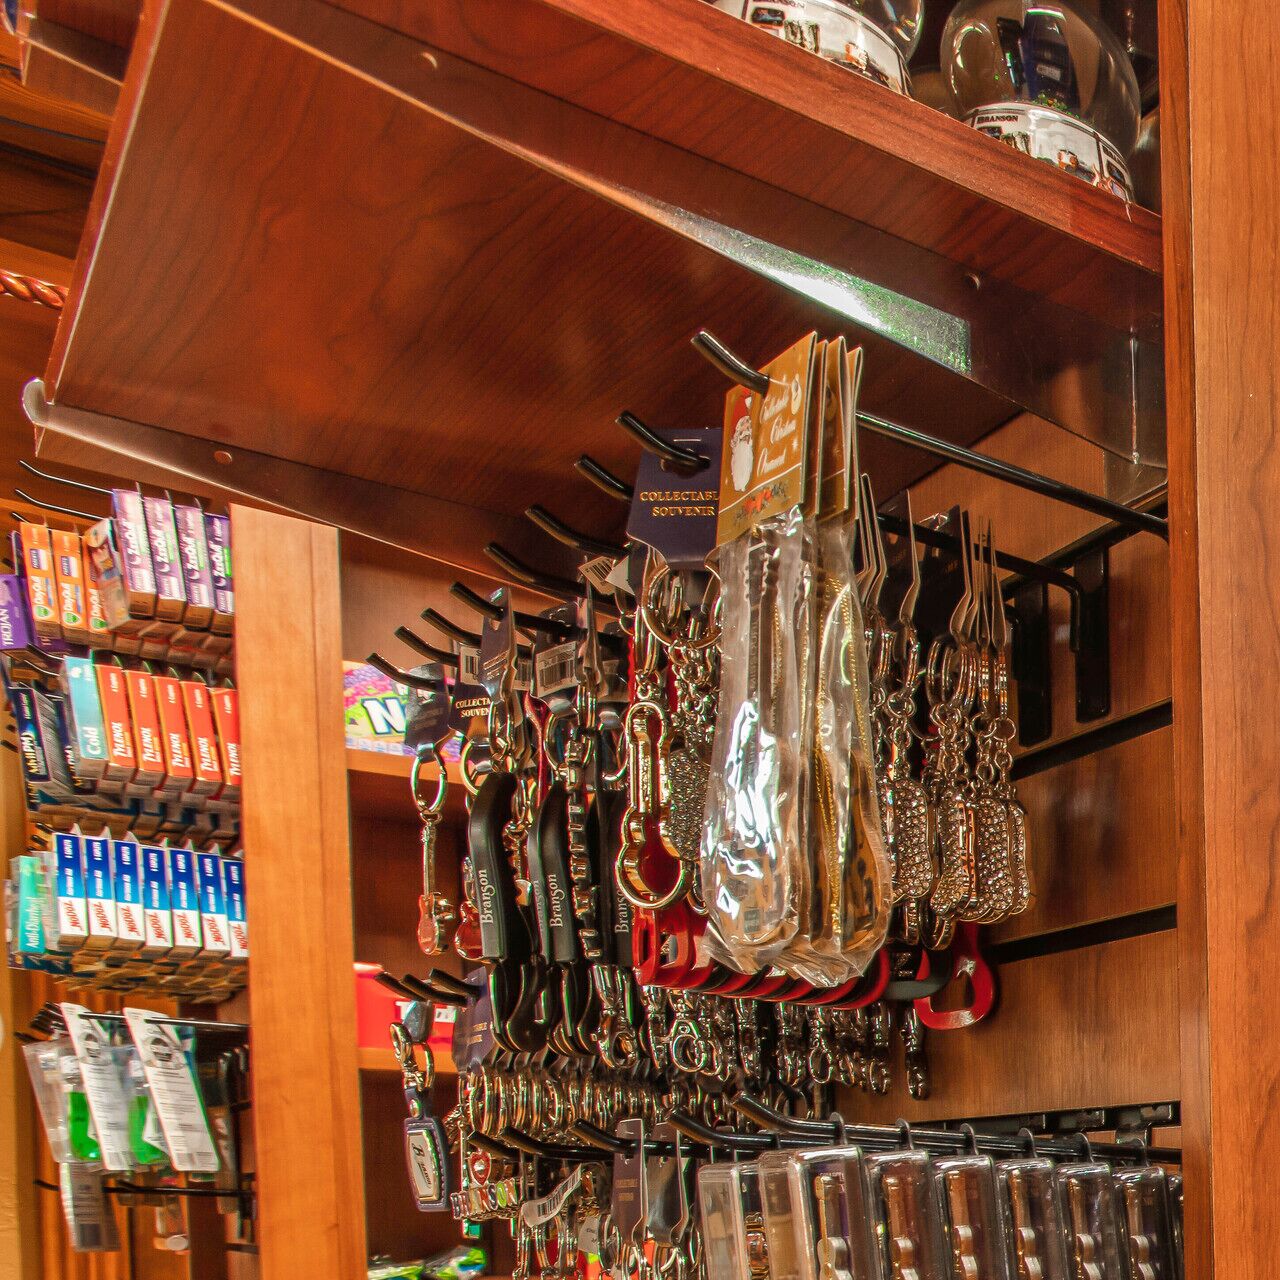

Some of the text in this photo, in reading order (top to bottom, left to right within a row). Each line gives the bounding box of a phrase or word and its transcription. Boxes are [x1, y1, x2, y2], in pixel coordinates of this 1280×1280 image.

[652, 505, 716, 517] SOUVENIR
[84, 726, 101, 755] Cold
[111, 721, 127, 758] TYLENOL
[140, 727, 156, 762] TYLENOL
[169, 733, 185, 768] TYLENOL
[197, 737, 214, 771] TYLENOL
[479, 869, 496, 925] Branson
[549, 873, 565, 928] Branson
